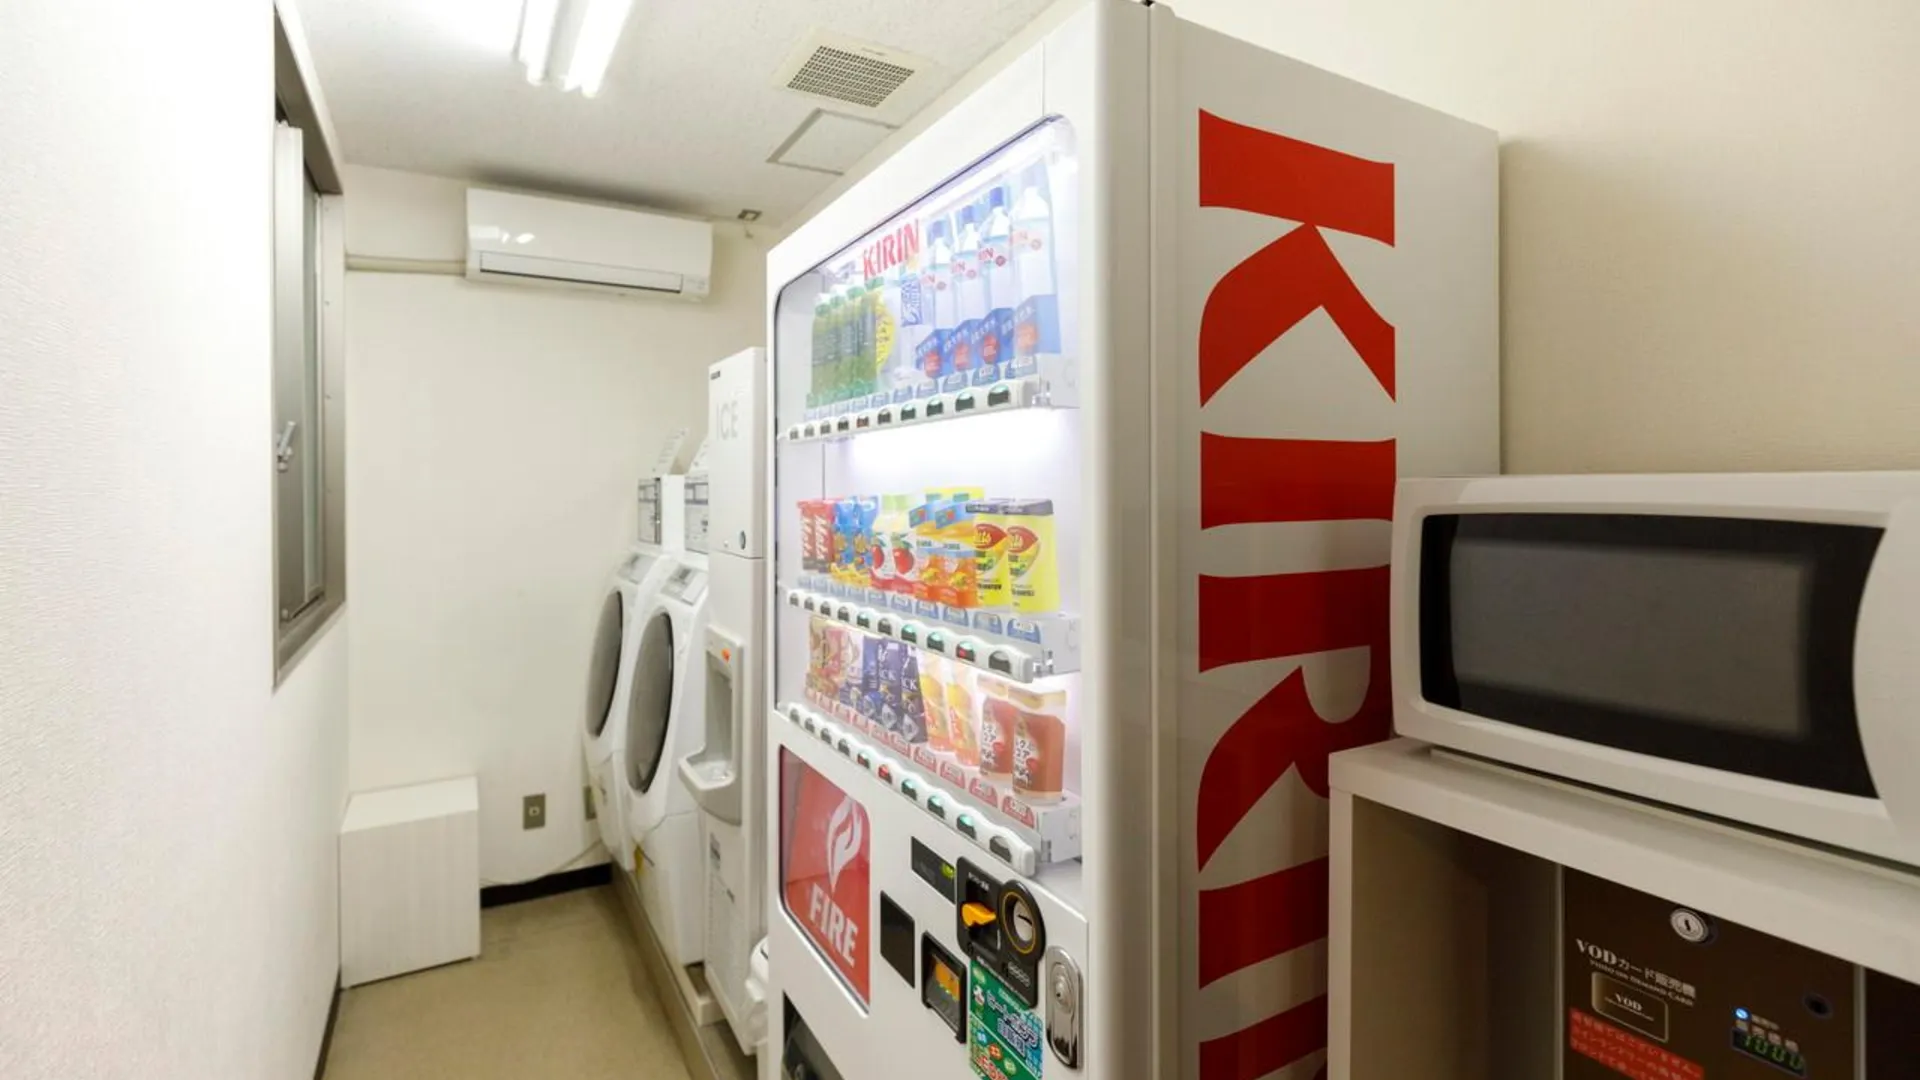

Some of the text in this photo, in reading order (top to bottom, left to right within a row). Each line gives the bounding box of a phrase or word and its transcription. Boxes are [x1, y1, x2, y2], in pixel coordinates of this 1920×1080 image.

[862, 218, 921, 280] KIRIN
[716, 399, 739, 442] ICE
[809, 882, 859, 968] FIRE
[1614, 993, 1643, 1012] VOD
